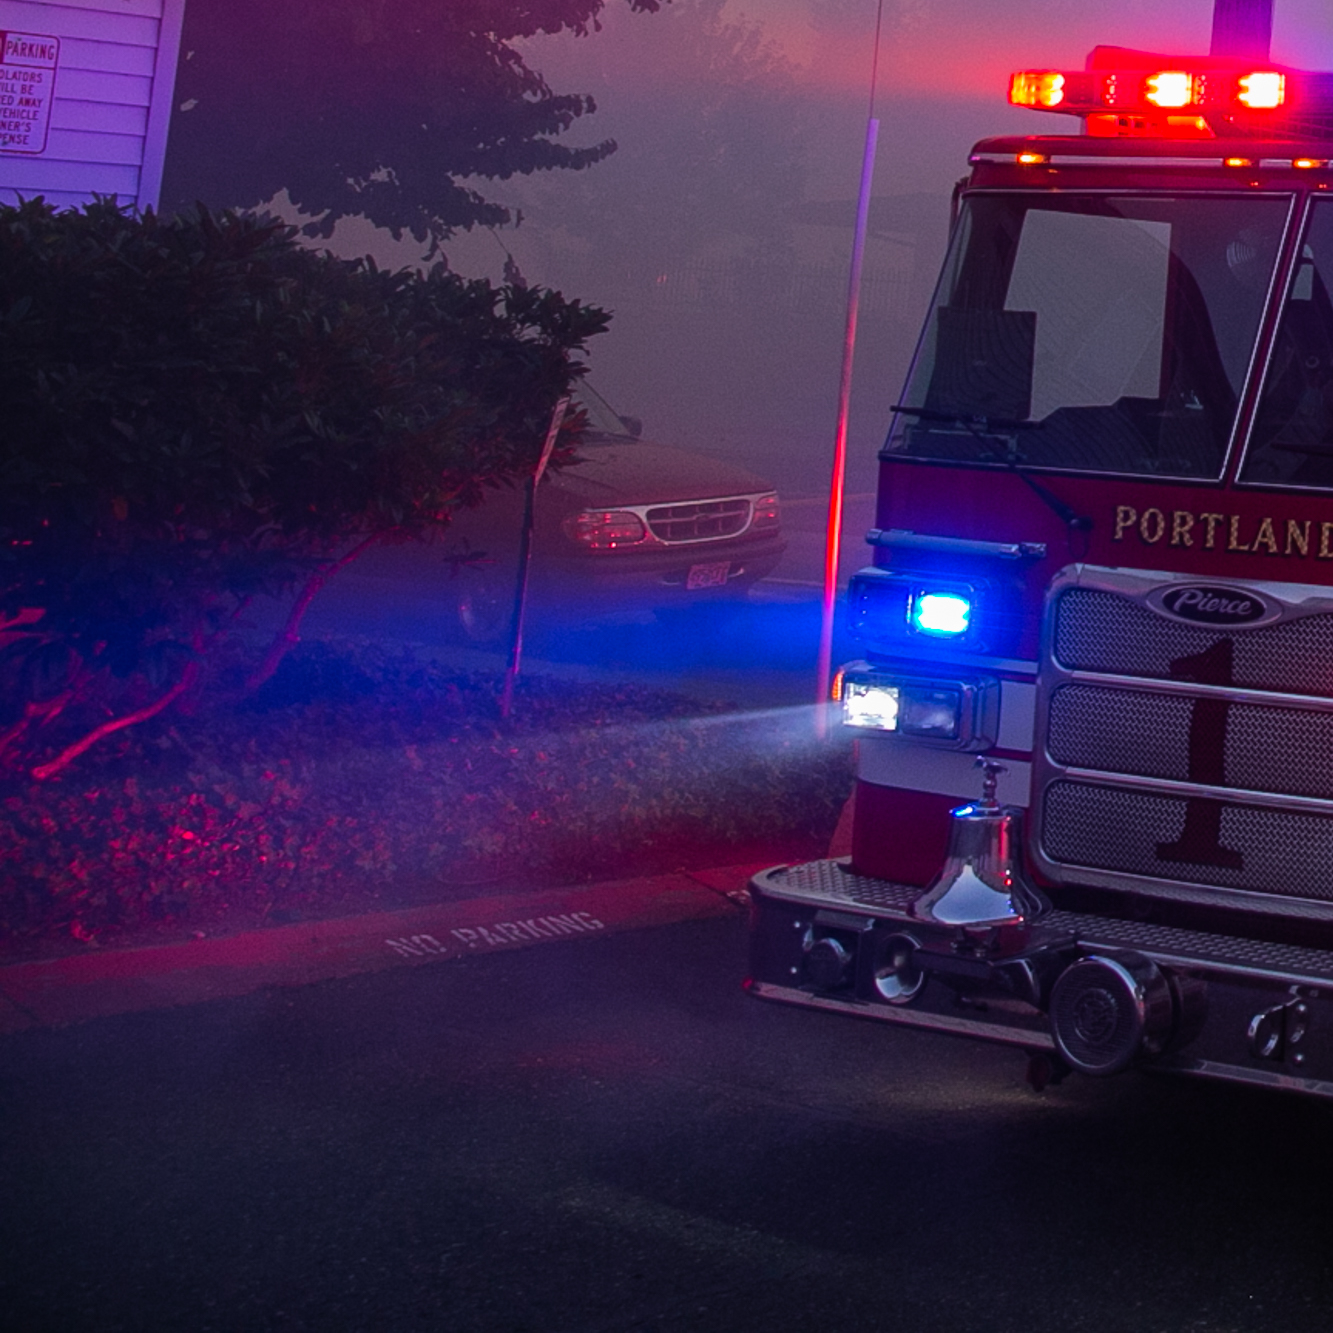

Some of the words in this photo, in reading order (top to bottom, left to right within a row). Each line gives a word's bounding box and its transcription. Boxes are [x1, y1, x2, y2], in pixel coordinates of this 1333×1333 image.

[6, 40, 54, 60] PARKING
[21, 84, 34, 96] BE
[18, 97, 43, 107] AWAY
[1171, 588, 1252, 615] Pierce
[1157, 637, 1244, 869] 1
[384, 933, 448, 958] NO
[451, 911, 605, 948] PARKING
